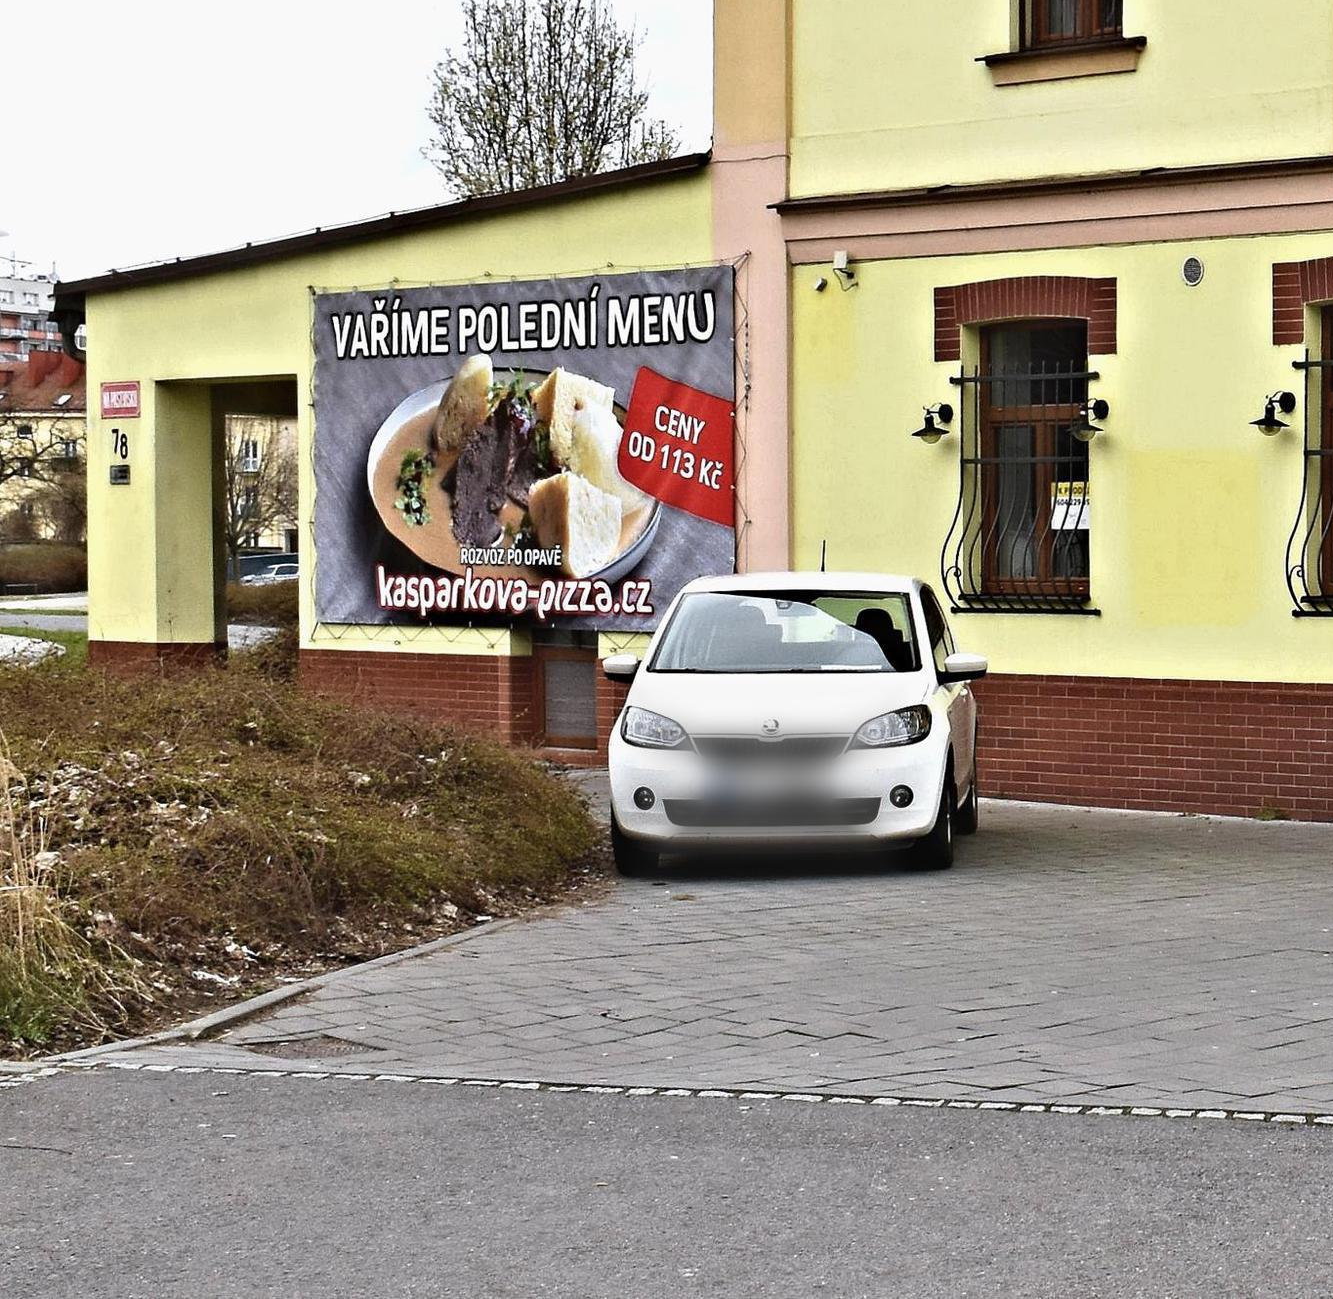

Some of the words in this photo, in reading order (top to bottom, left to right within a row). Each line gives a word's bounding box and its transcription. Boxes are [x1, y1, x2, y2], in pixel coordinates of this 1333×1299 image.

[332, 297, 450, 359] VAŘÍME
[458, 286, 600, 353] POLEDNÍ
[607, 291, 716, 345] MENU
[111, 428, 129, 460] 78
[654, 405, 706, 444] CENY
[628, 431, 656, 461] OD
[660, 444, 694, 479] 113
[699, 455, 724, 490] Kč
[460, 547, 505, 566] ROZVOZ
[507, 548, 523, 566] PO
[525, 544, 562, 566] OPAVĚ
[377, 565, 653, 619] kasparkova-pizza.cz
